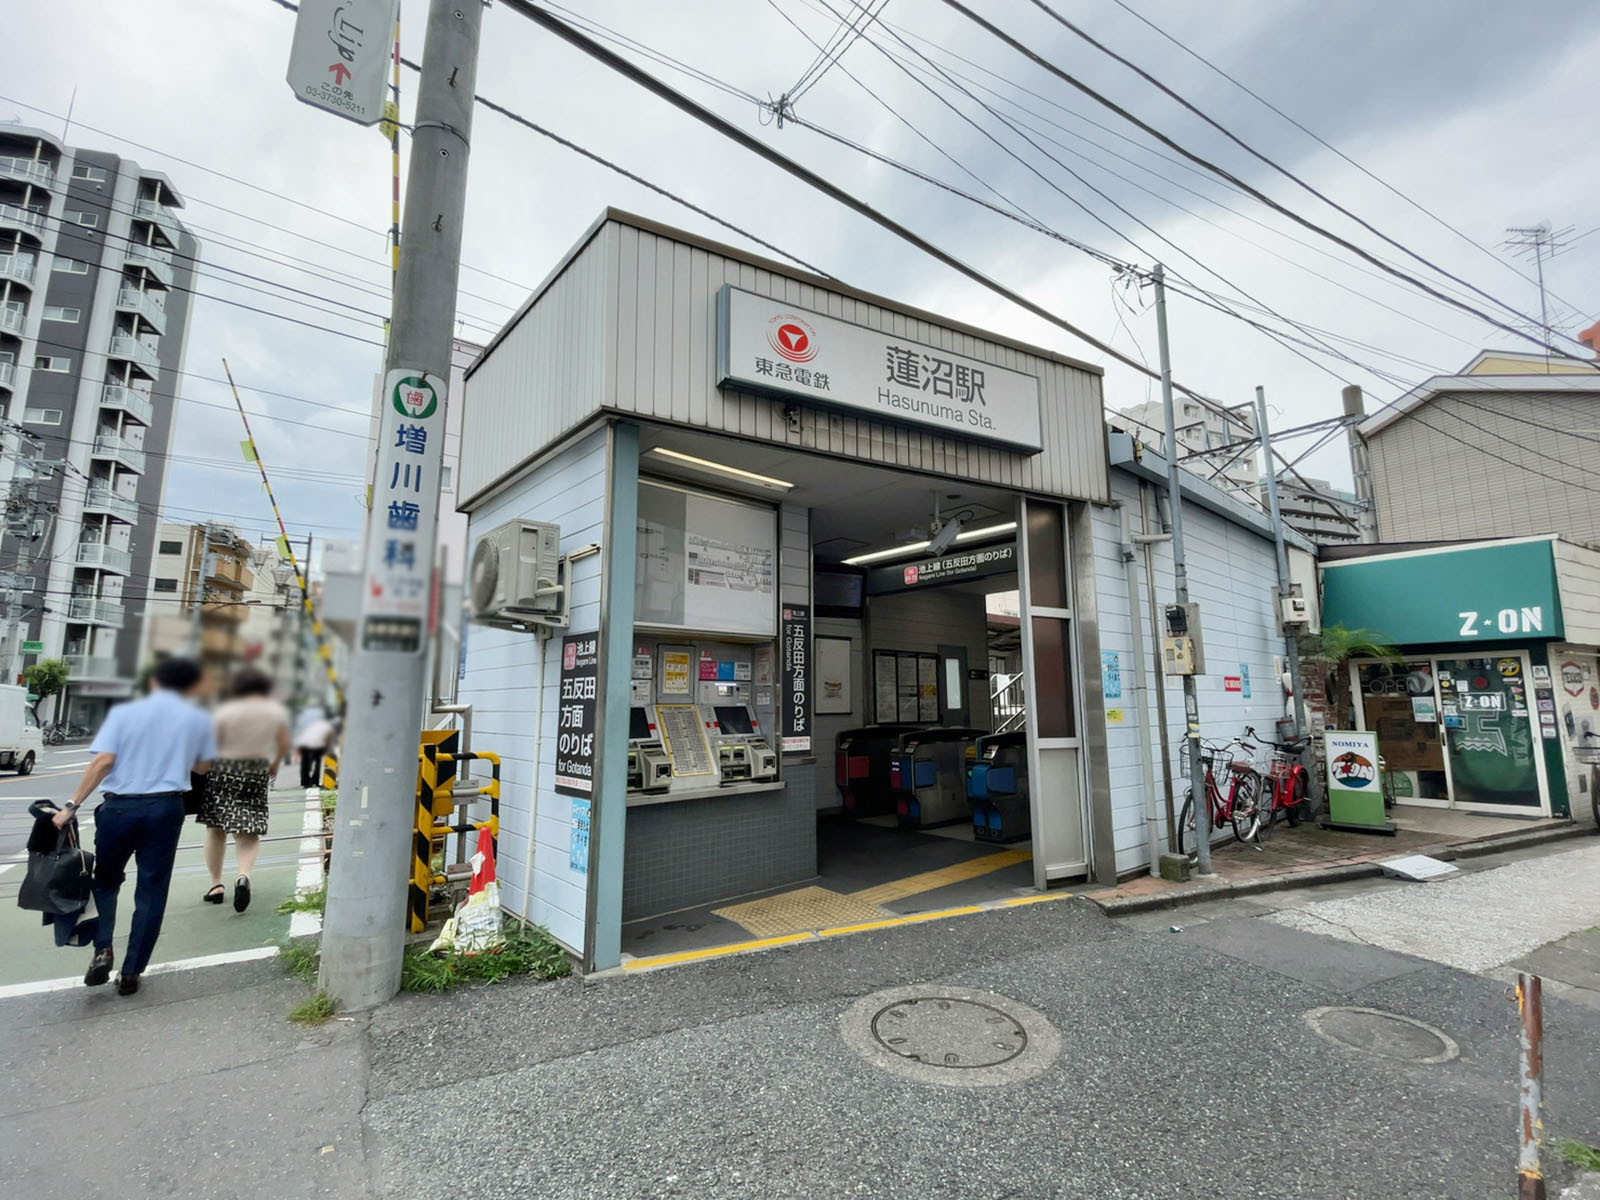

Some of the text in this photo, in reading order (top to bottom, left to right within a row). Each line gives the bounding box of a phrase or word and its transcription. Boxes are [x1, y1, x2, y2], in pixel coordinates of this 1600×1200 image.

[305, 85, 365, 115] 03-3730-5211
[320, 81, 354, 101] この先
[754, 356, 831, 392] 東急電鉄
[886, 344, 987, 407] 蓮沼駅
[877, 386, 997, 432] Hasunuma Sta.
[576, 640, 596, 656] 池上線
[561, 676, 596, 700] 五反田
[793, 624, 805, 732] 五反田方面のりば
[560, 705, 584, 728] 方面
[559, 733, 593, 757] のりば
[1331, 741, 1369, 749] NOMIYA
[558, 759, 592, 776] for Gotanda
